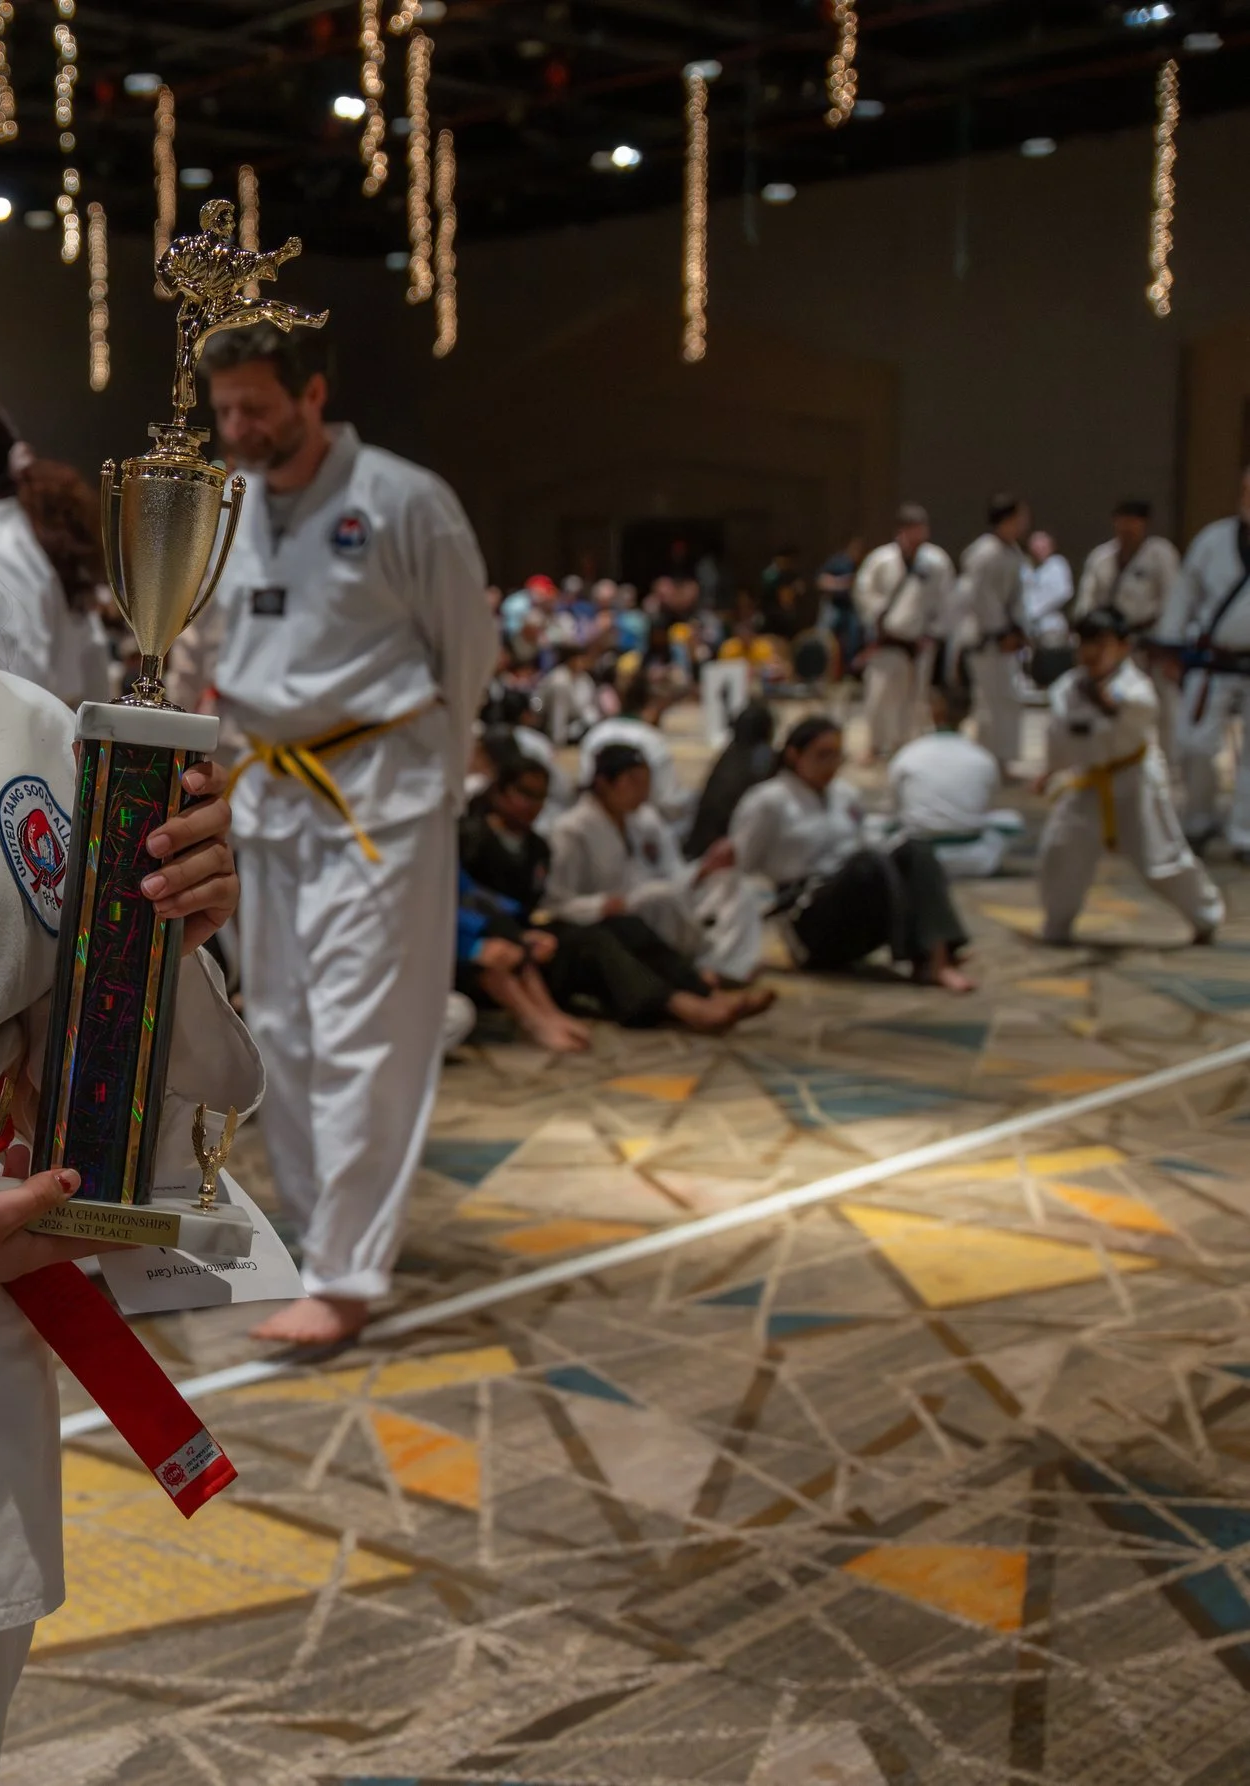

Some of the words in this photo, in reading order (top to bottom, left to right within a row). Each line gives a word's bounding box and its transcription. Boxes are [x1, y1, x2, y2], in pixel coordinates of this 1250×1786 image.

[23, 783, 44, 799] SOO
[3, 788, 25, 816] TANG
[4, 820, 27, 878] UNITED
[55, 1206, 73, 1219] MA
[76, 1208, 172, 1231] CHAMPIONSHIPS
[38, 1218, 63, 1230] 2026
[73, 1223, 92, 1235] 1ST
[94, 1225, 134, 1240] PLACE
[146, 1269, 172, 1280] Card
[173, 1265, 201, 1276] Entry
[202, 1261, 258, 1274] Competitor
